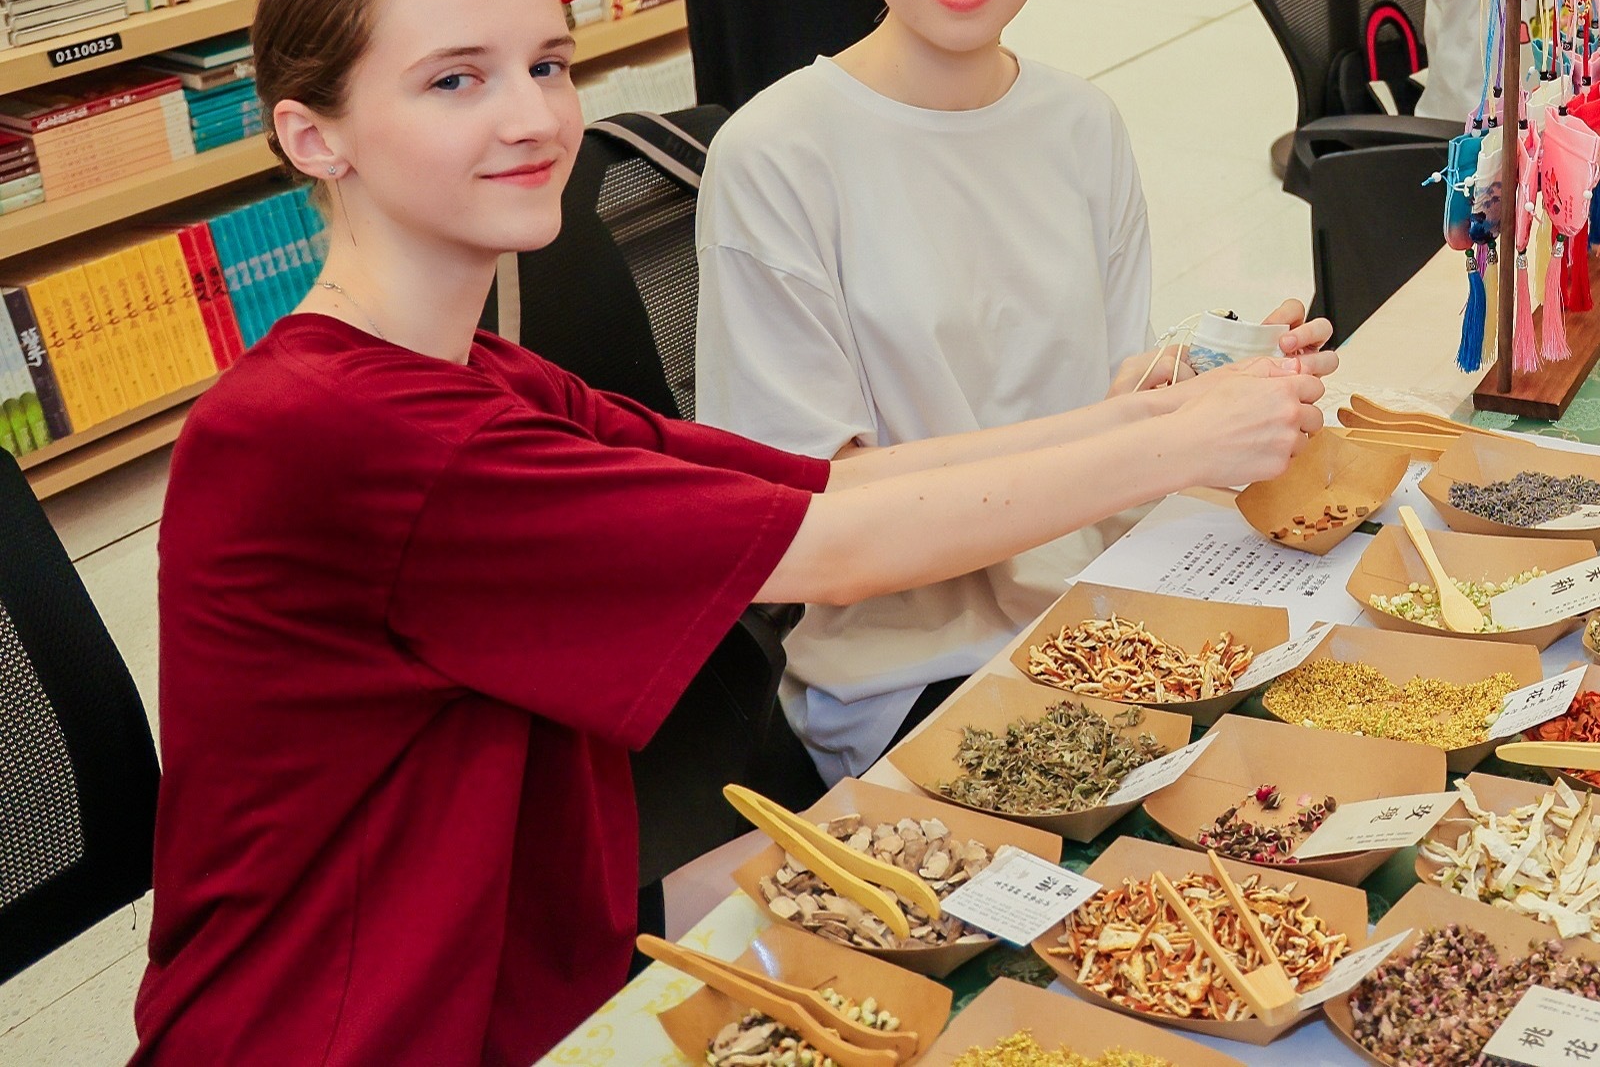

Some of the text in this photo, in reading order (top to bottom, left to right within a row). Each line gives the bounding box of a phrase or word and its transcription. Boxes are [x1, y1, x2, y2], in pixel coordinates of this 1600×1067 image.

[55, 37, 115, 63] 0110035
[1525, 679, 1570, 703] 桂花
[1369, 802, 1435, 825] 玫瑰
[1517, 1025, 1600, 1061] 桃花
